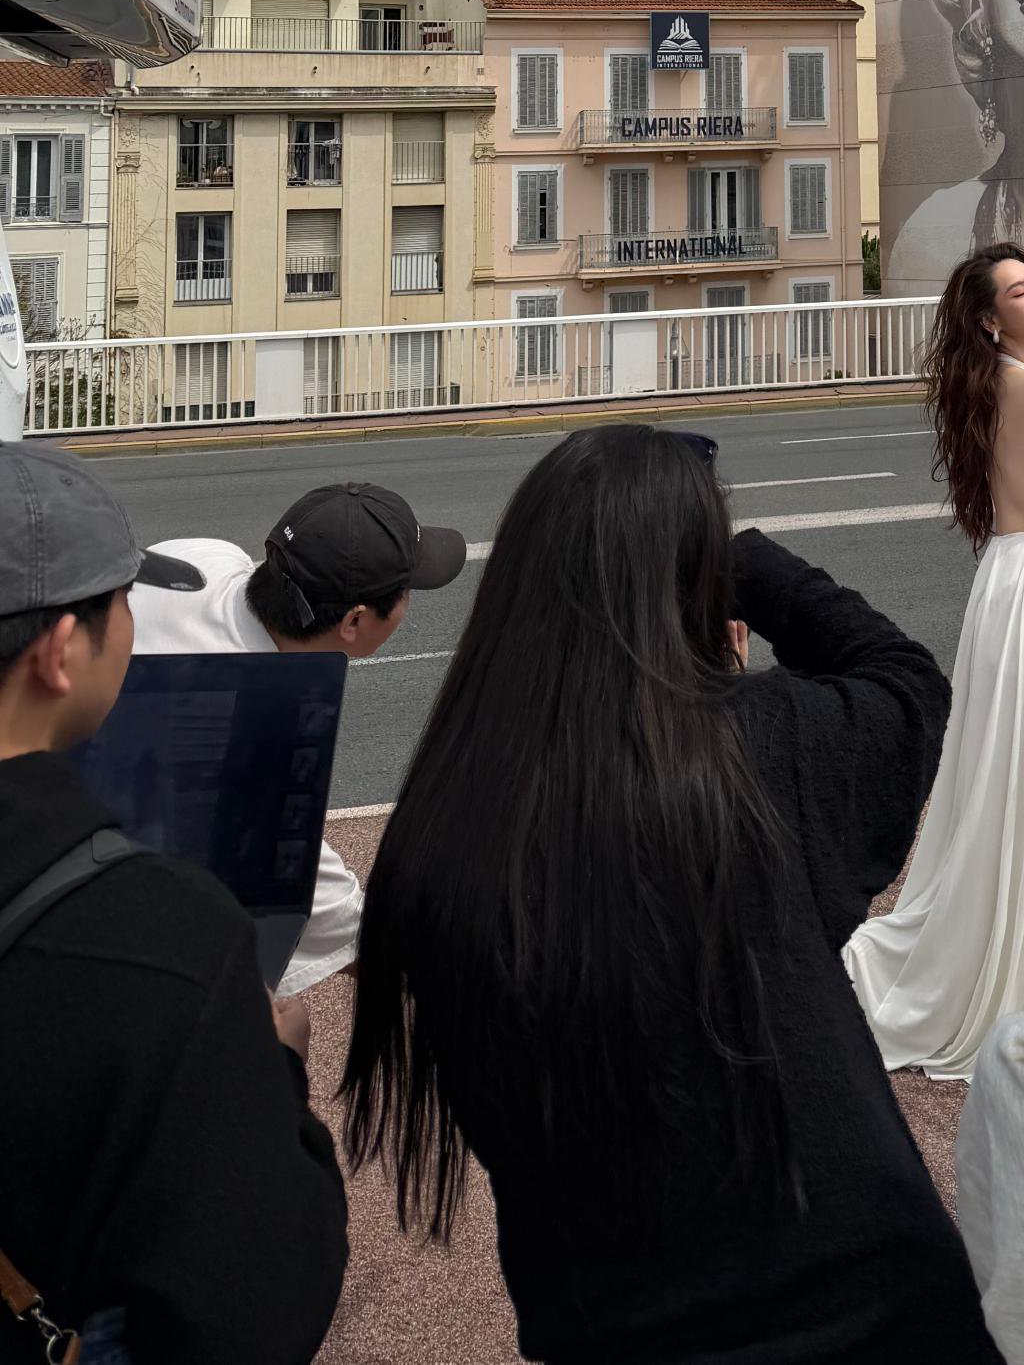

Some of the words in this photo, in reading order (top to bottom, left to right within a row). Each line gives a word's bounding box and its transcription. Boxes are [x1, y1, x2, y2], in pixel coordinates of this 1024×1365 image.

[657, 54, 683, 63] CAMPUS
[684, 54, 703, 63] RIERA
[621, 117, 692, 138] CAMPUS
[696, 116, 744, 136] RIERA
[616, 235, 746, 262] INTERNATIONAL
